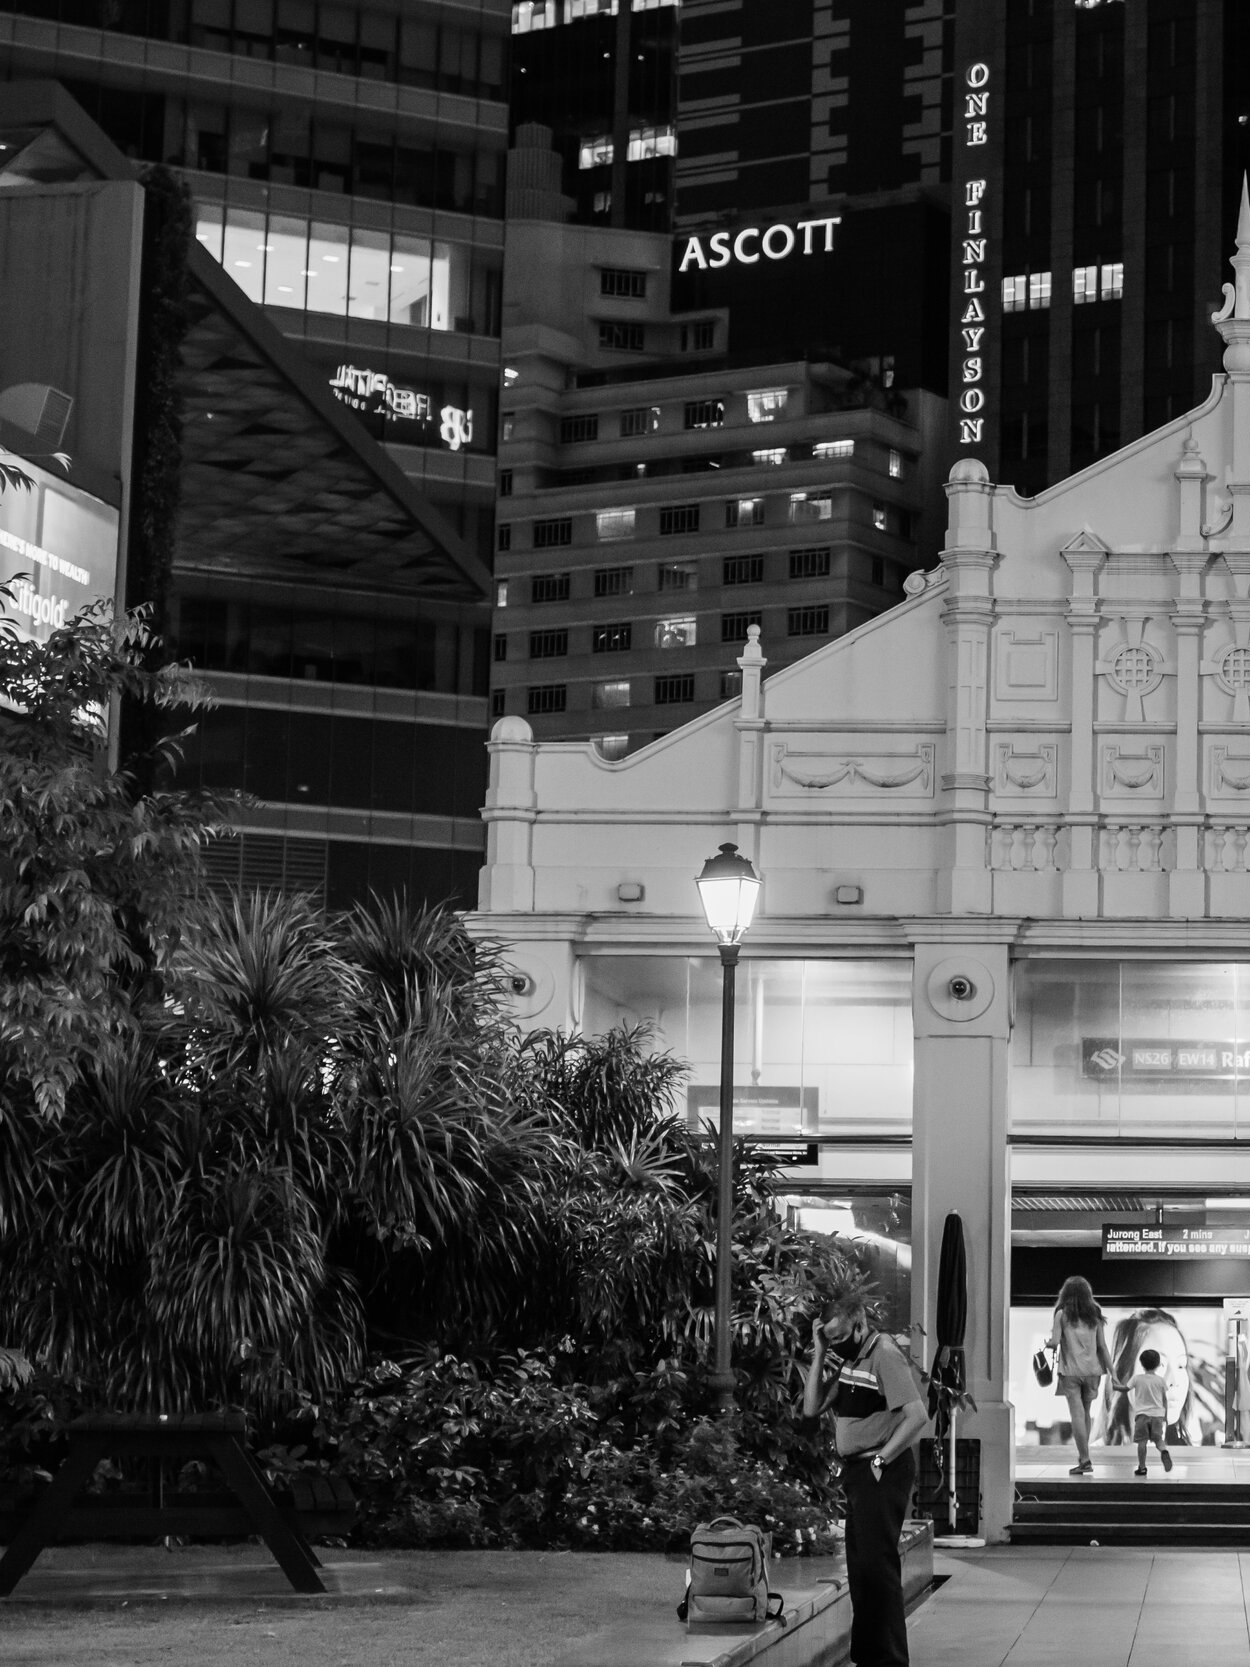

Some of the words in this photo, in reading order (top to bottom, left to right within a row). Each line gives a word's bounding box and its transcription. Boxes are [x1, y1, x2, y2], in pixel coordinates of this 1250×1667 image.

[964, 62, 990, 146] ONE
[678, 216, 842, 272] ASCOTT
[959, 179, 987, 444] FINLAYSON
[60, 558, 90, 585] WEALTH
[1107, 1229, 1140, 1241] Jurong
[1142, 1229, 1163, 1239] East
[1182, 1229, 1189, 1239] 2
[1190, 1229, 1213, 1239] mins
[1158, 1241, 1166, 1253] If
[1166, 1243, 1187, 1255] you
[1188, 1243, 1208, 1253] see
[1208, 1243, 1228, 1255] any
